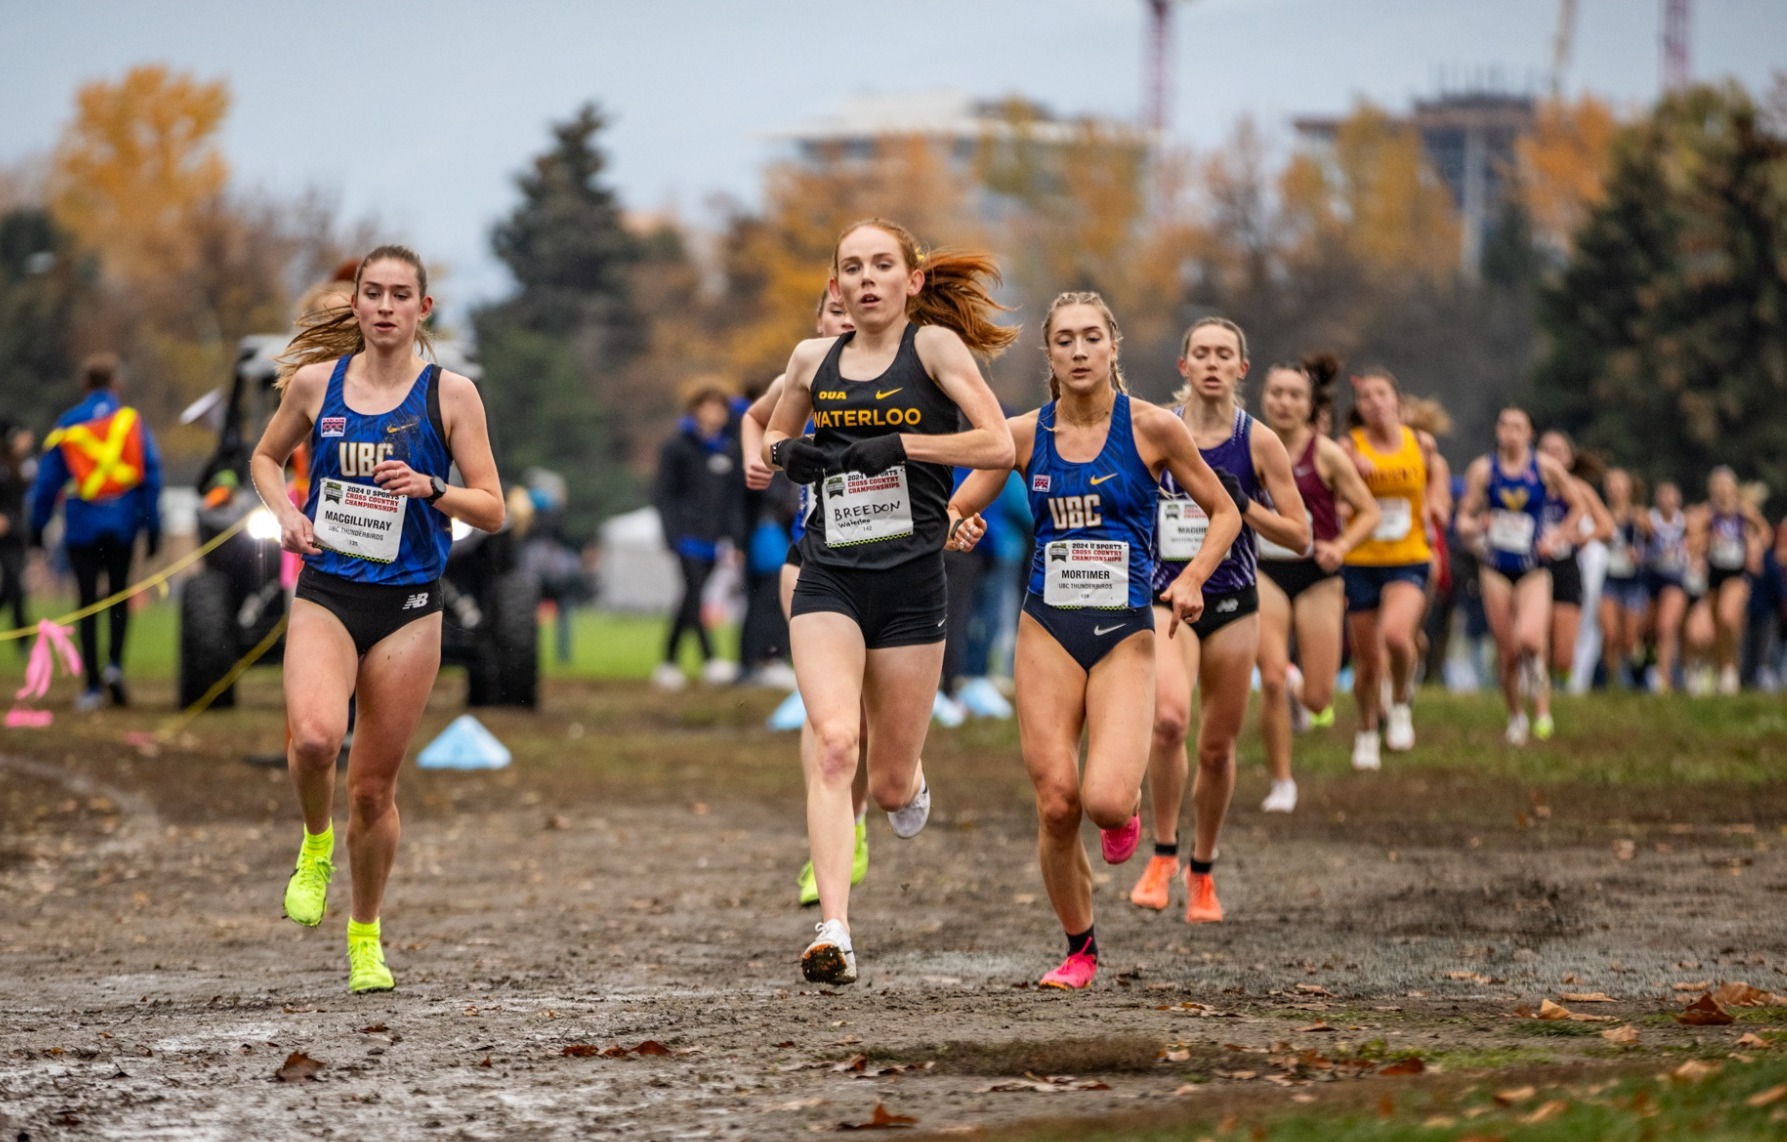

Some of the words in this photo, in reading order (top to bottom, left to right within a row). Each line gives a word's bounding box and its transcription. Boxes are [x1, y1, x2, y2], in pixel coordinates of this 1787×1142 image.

[818, 391, 847, 400] OUA
[847, 479, 868, 487] CROSS
[869, 476, 899, 484] COUNTRY
[848, 482, 900, 494] CHAMPIONSHIPS
[347, 485, 364, 494] 2024
[344, 499, 398, 513] CHAMPIONSHIPS
[345, 492, 367, 501] CROSS
[368, 496, 399, 507] COUNTRY
[834, 500, 900, 521] BREEDON
[1048, 494, 1101, 530] UBC
[324, 510, 392, 531] MACGILLIVRAY
[340, 527, 384, 541] THUNDERBIRDS
[1061, 570, 1110, 580] MORTIMER
